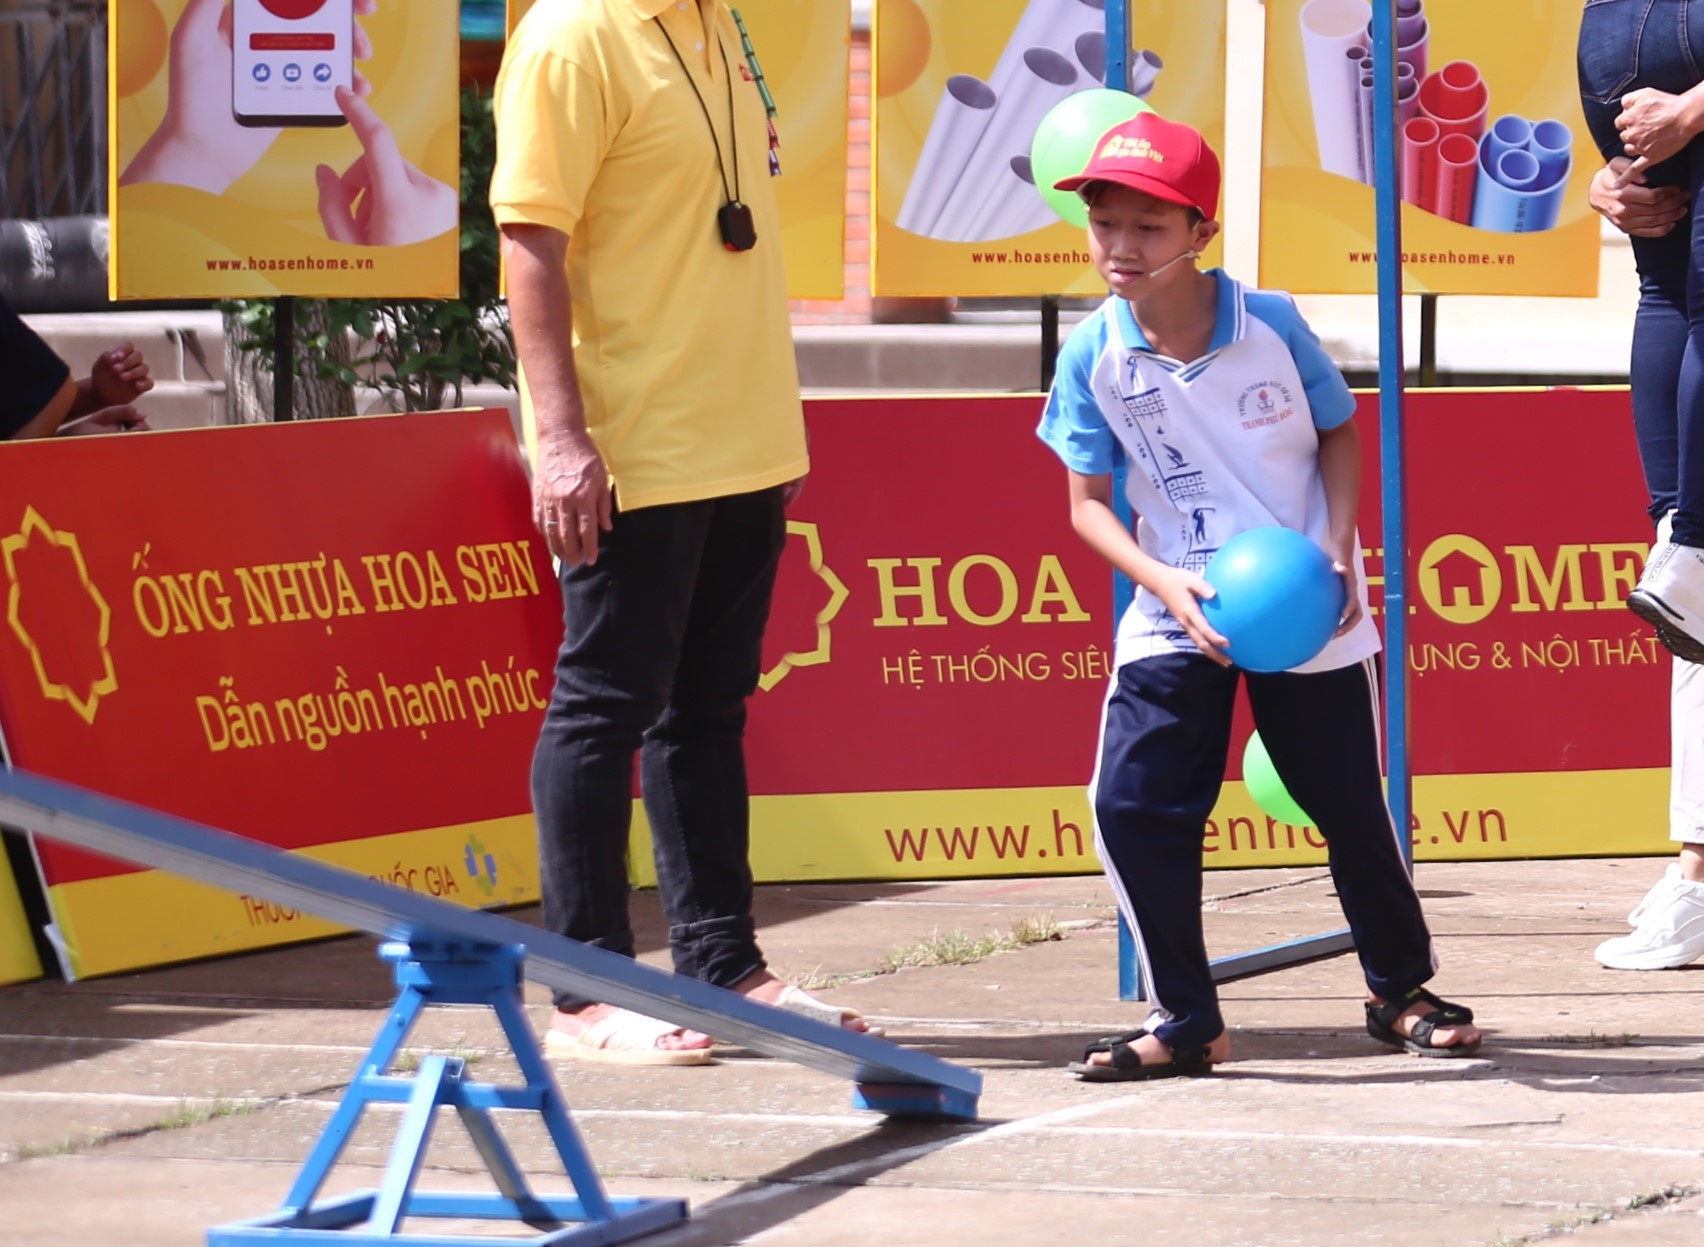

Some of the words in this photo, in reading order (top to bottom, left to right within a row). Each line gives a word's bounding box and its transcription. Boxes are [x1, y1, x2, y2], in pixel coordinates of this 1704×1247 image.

[206, 256, 374, 271] www.hoasenhome.vn
[972, 249, 1091, 264] www.hoasenho
[132, 542, 235, 638] ỐNG
[234, 551, 366, 636] NHỰA
[361, 550, 457, 612] HOA
[455, 540, 541, 603] SEN
[867, 553, 1091, 627] HOA
[882, 648, 924, 690] HỆ
[932, 644, 1051, 684] THỐNG
[1410, 641, 1481, 678] ỰNG
[1492, 642, 1512, 669] &
[1523, 634, 1581, 674] NỘI
[1588, 628, 1660, 666] THẤT
[195, 675, 276, 752] Dẫn
[274, 665, 384, 751] nguồn
[378, 665, 467, 741] hạnh
[465, 656, 548, 729] phúc
[424, 864, 460, 896] GIA
